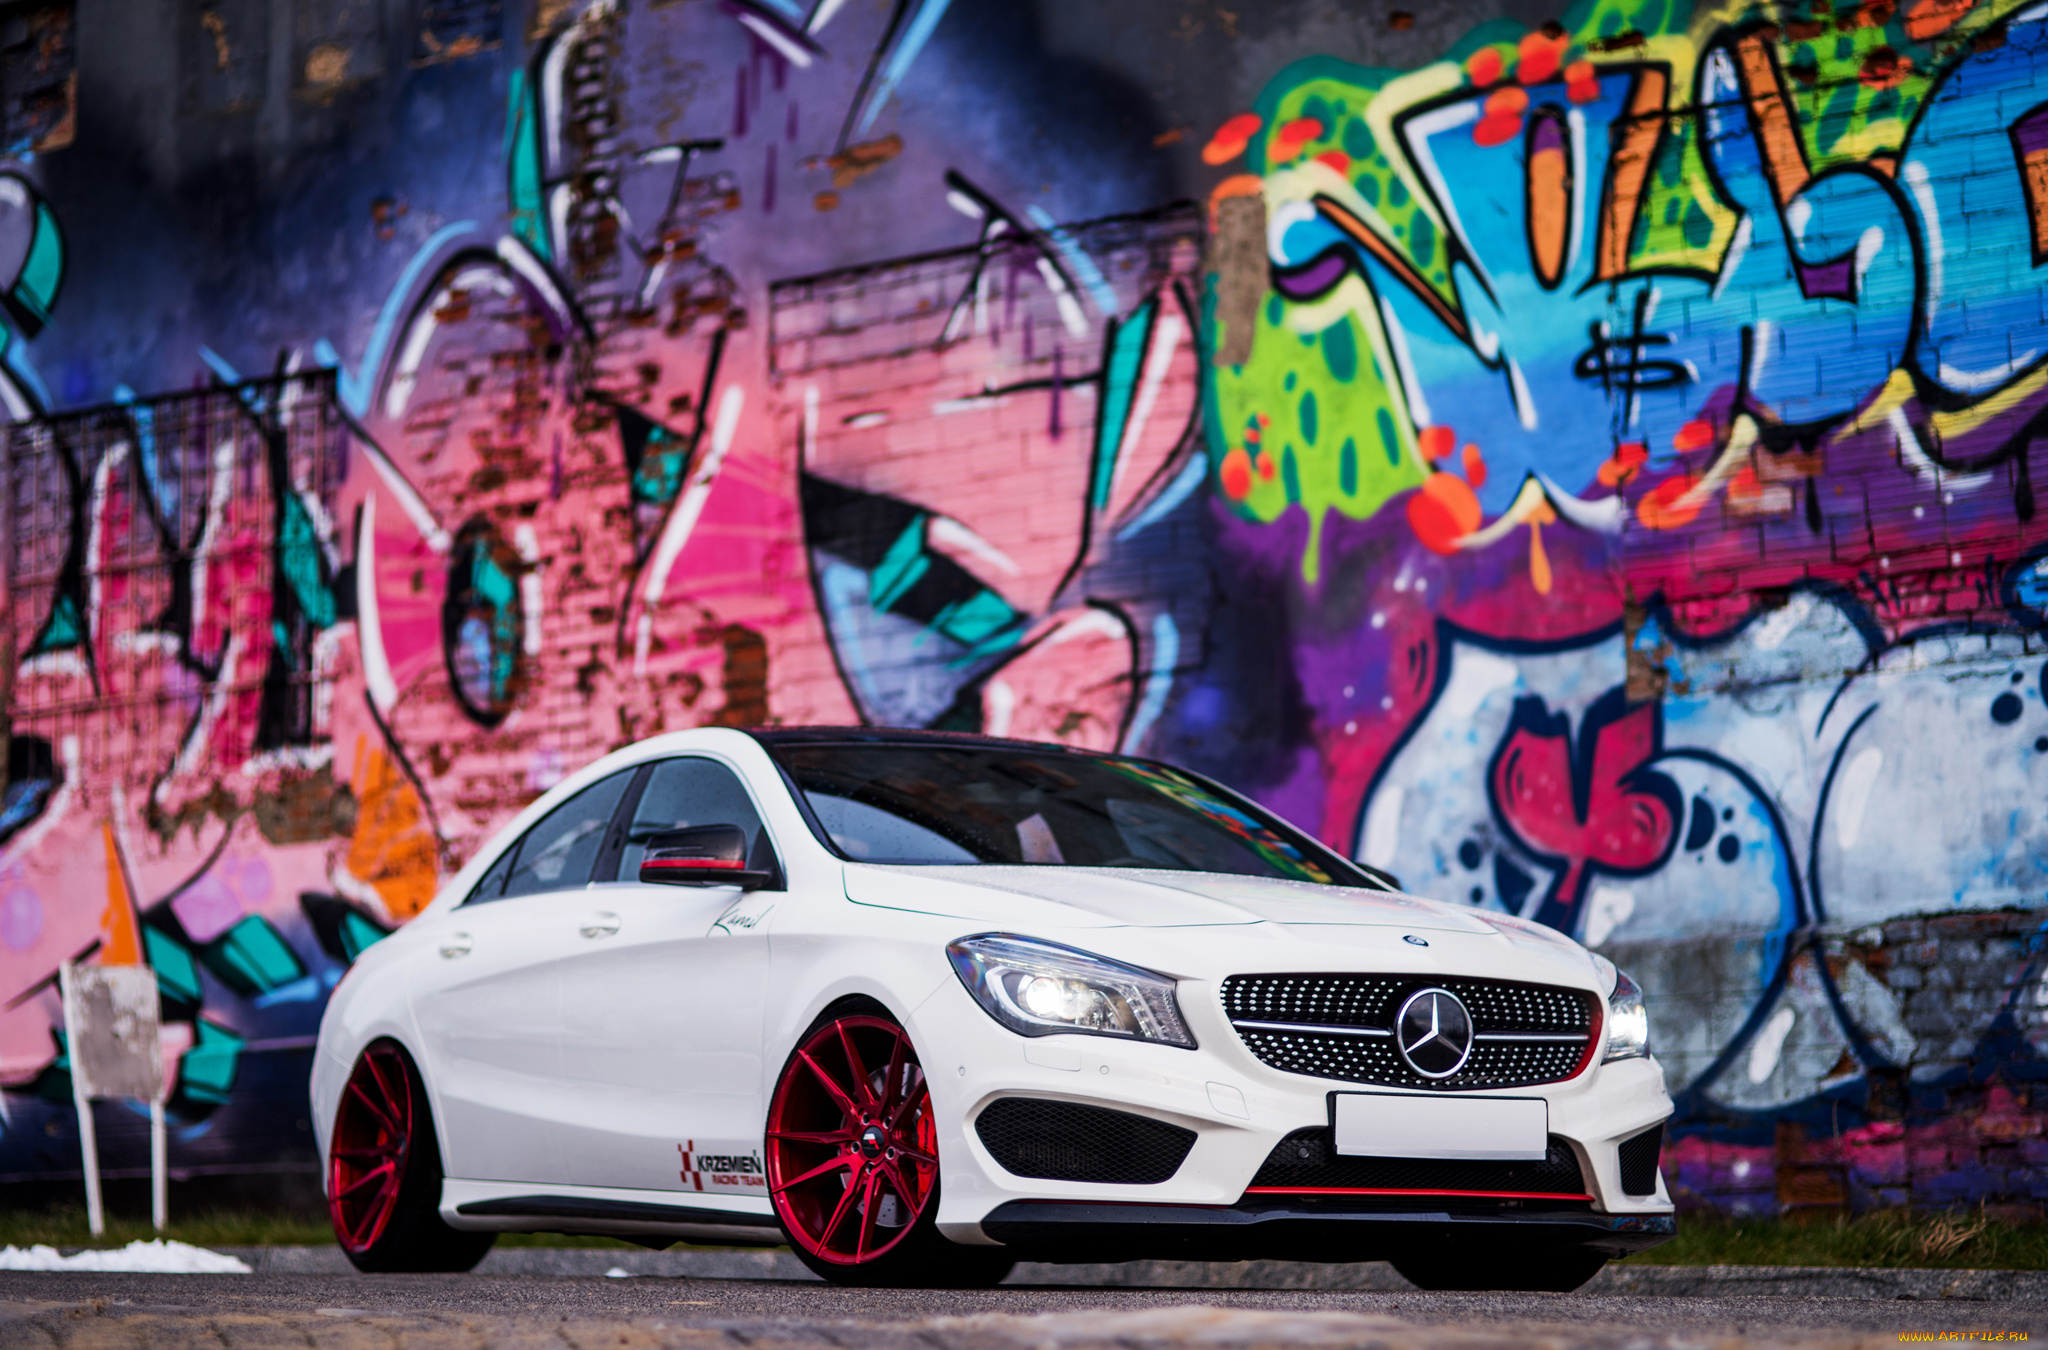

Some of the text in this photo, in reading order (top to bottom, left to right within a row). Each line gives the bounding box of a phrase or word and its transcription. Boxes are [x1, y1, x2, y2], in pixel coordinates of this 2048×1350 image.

[696, 1149, 763, 1174] KRZEMIEŃ
[711, 1174, 766, 1187] RACING TEAM
